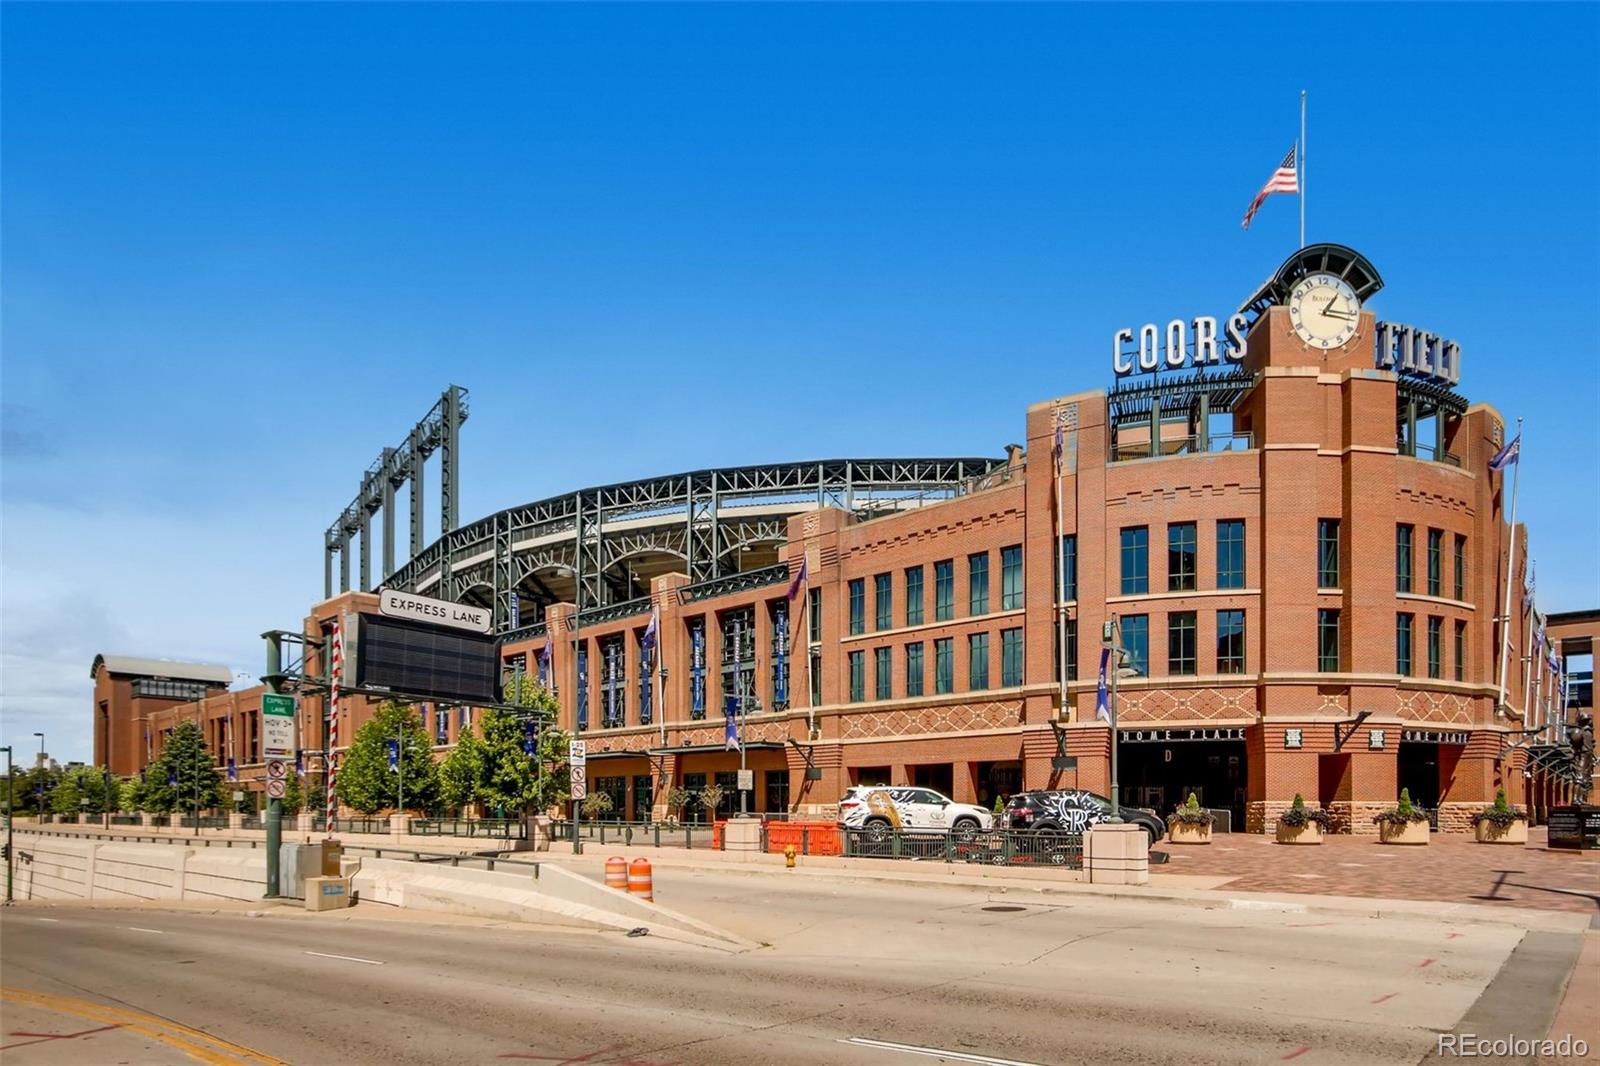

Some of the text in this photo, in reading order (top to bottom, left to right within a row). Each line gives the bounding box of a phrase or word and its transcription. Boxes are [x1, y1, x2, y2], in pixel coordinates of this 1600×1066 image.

[1304, 280, 1313, 290] 11
[1319, 277, 1328, 286] 12
[1307, 333, 1314, 341] 7
[1336, 335, 1343, 344] 5
[1114, 313, 1248, 374] COORS
[1377, 321, 1461, 384] FIELD
[390, 597, 482, 625] EXPRESS LANE
[1122, 728, 1244, 742] HOME PLATE
[1405, 730, 1429, 741] OME
[1165, 750, 1172, 762] D
